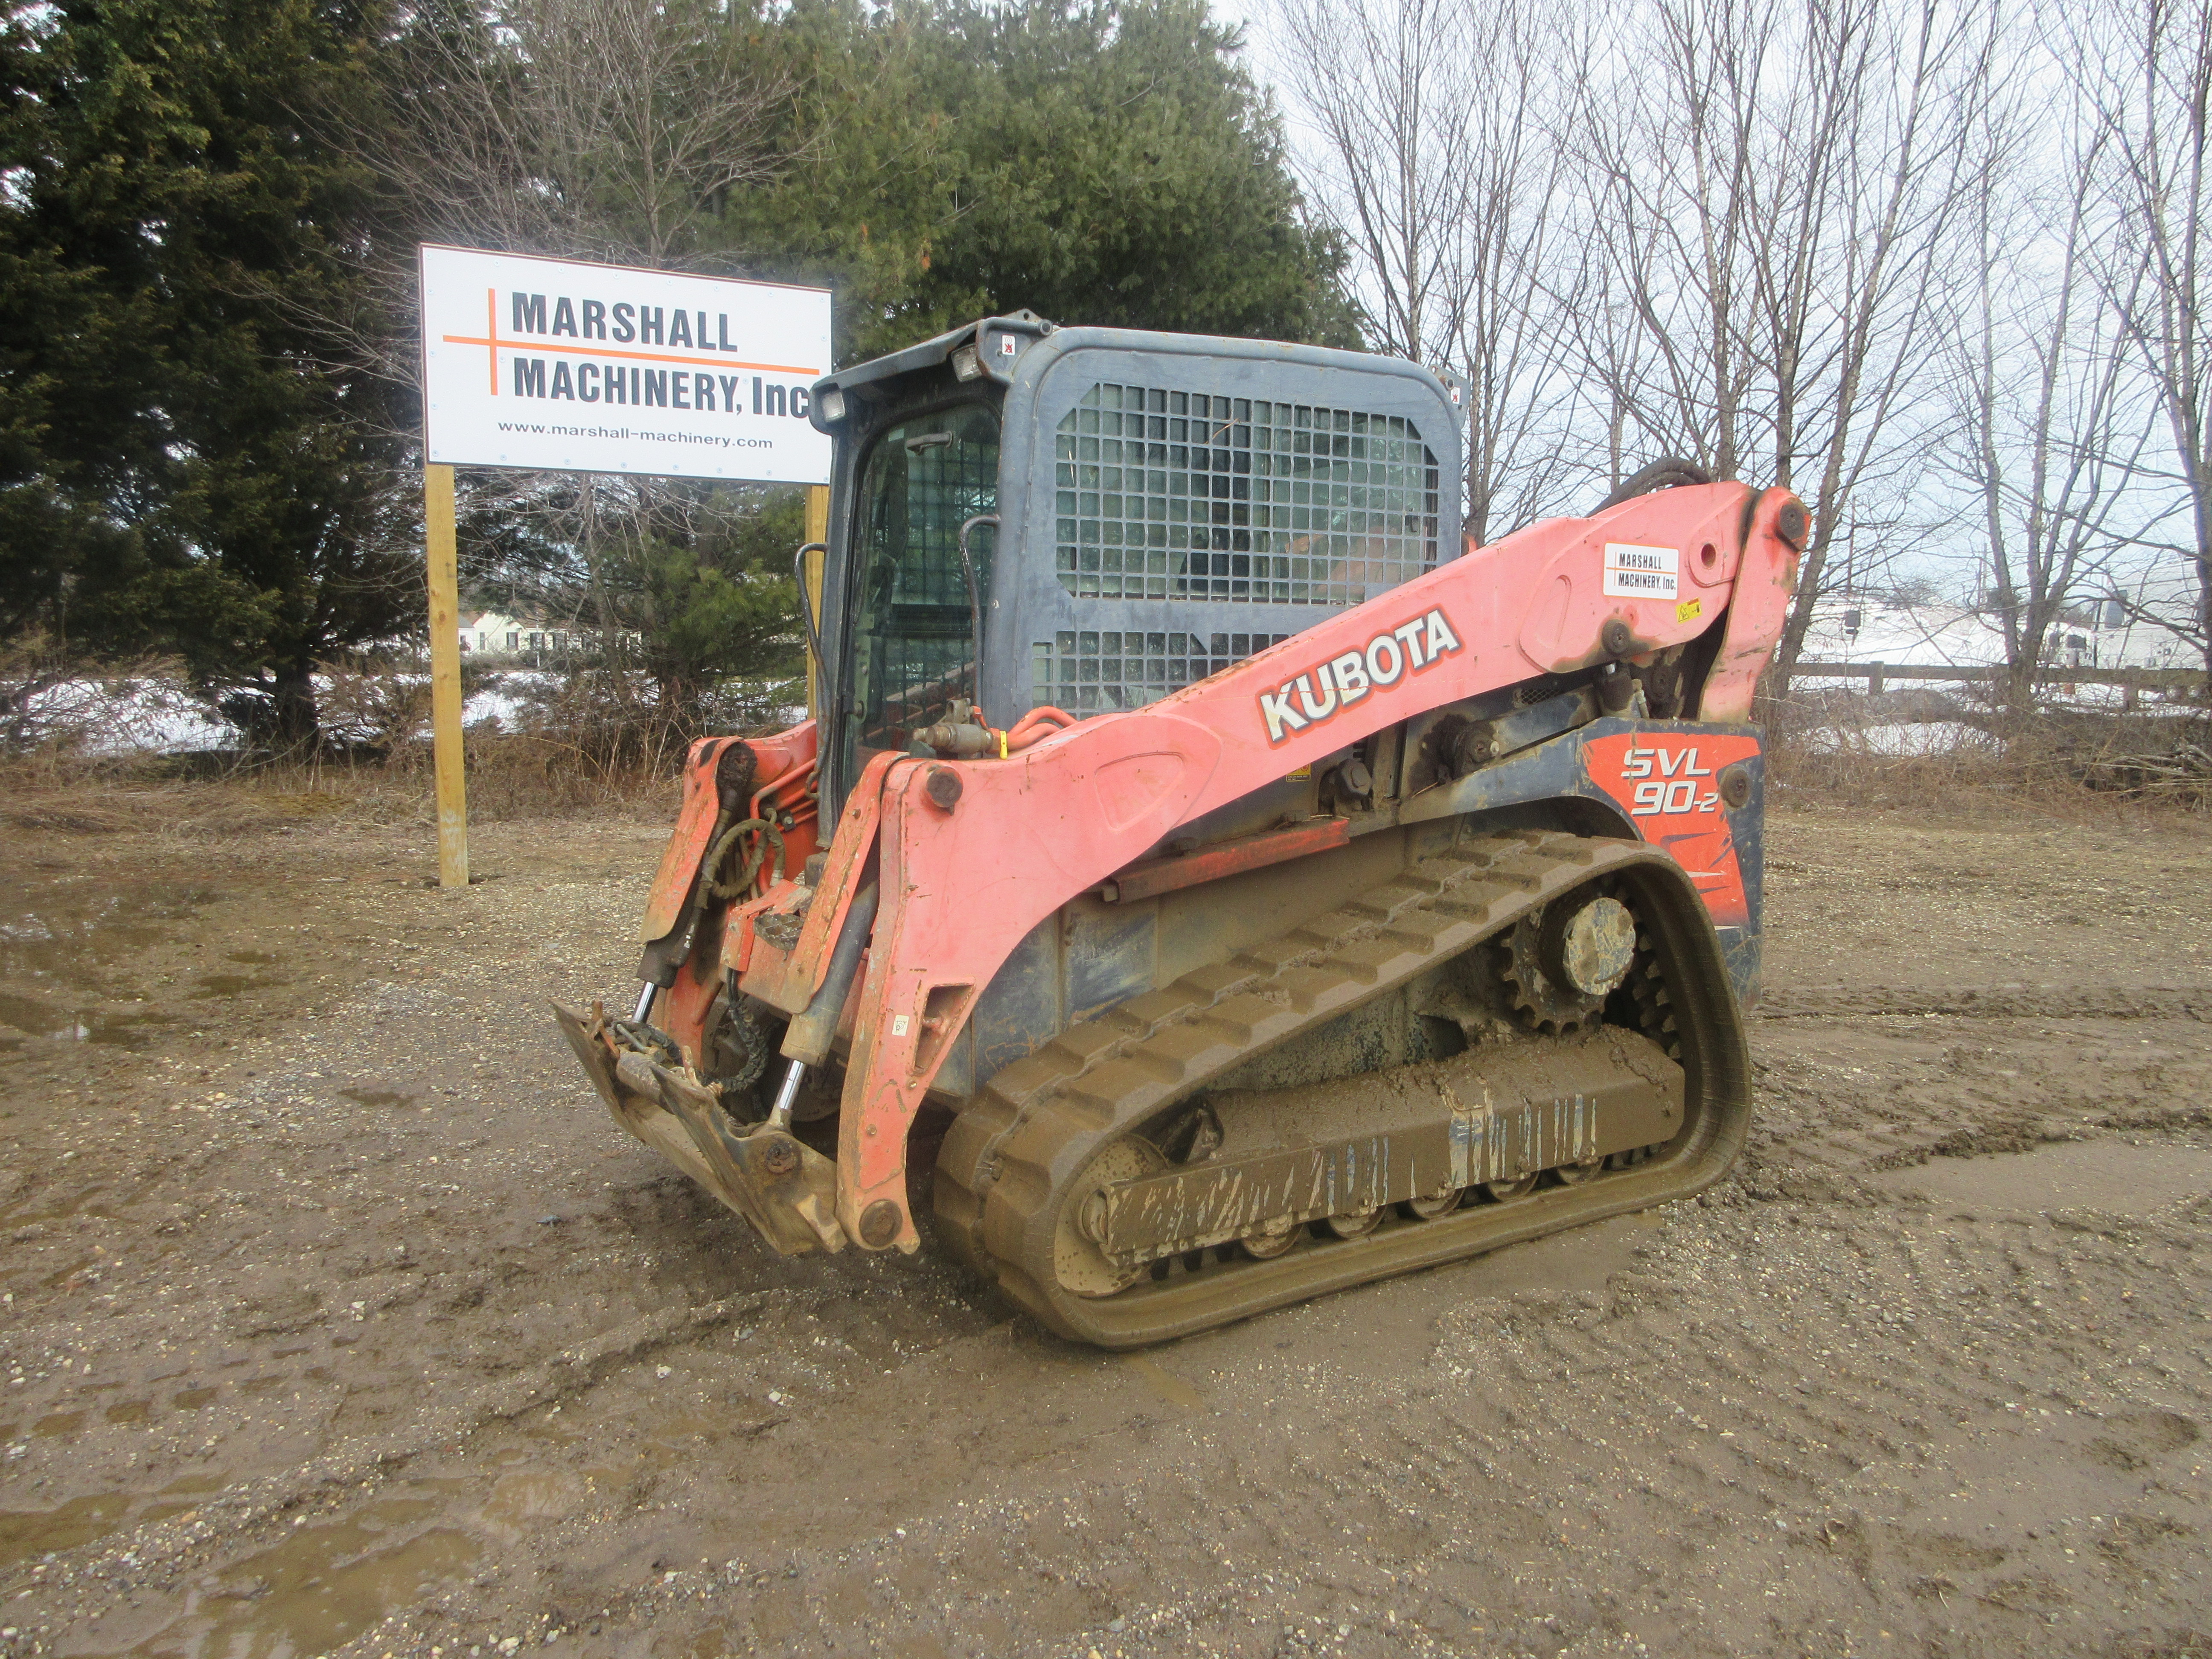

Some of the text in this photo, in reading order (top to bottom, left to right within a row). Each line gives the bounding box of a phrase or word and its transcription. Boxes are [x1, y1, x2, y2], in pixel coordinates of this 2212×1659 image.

[512, 291, 738, 352] MARSHALL
[514, 357, 743, 416] MACHINERY,
[498, 422, 774, 449] www.marshall-machinery.com
[1619, 553, 1662, 569] MARSHALL
[1618, 573, 1676, 590] MACHINERY, Inc.
[1260, 609, 1459, 742] KUBOTA
[1620, 748, 1711, 777] SVL
[1631, 780, 1719, 816] 90-2
